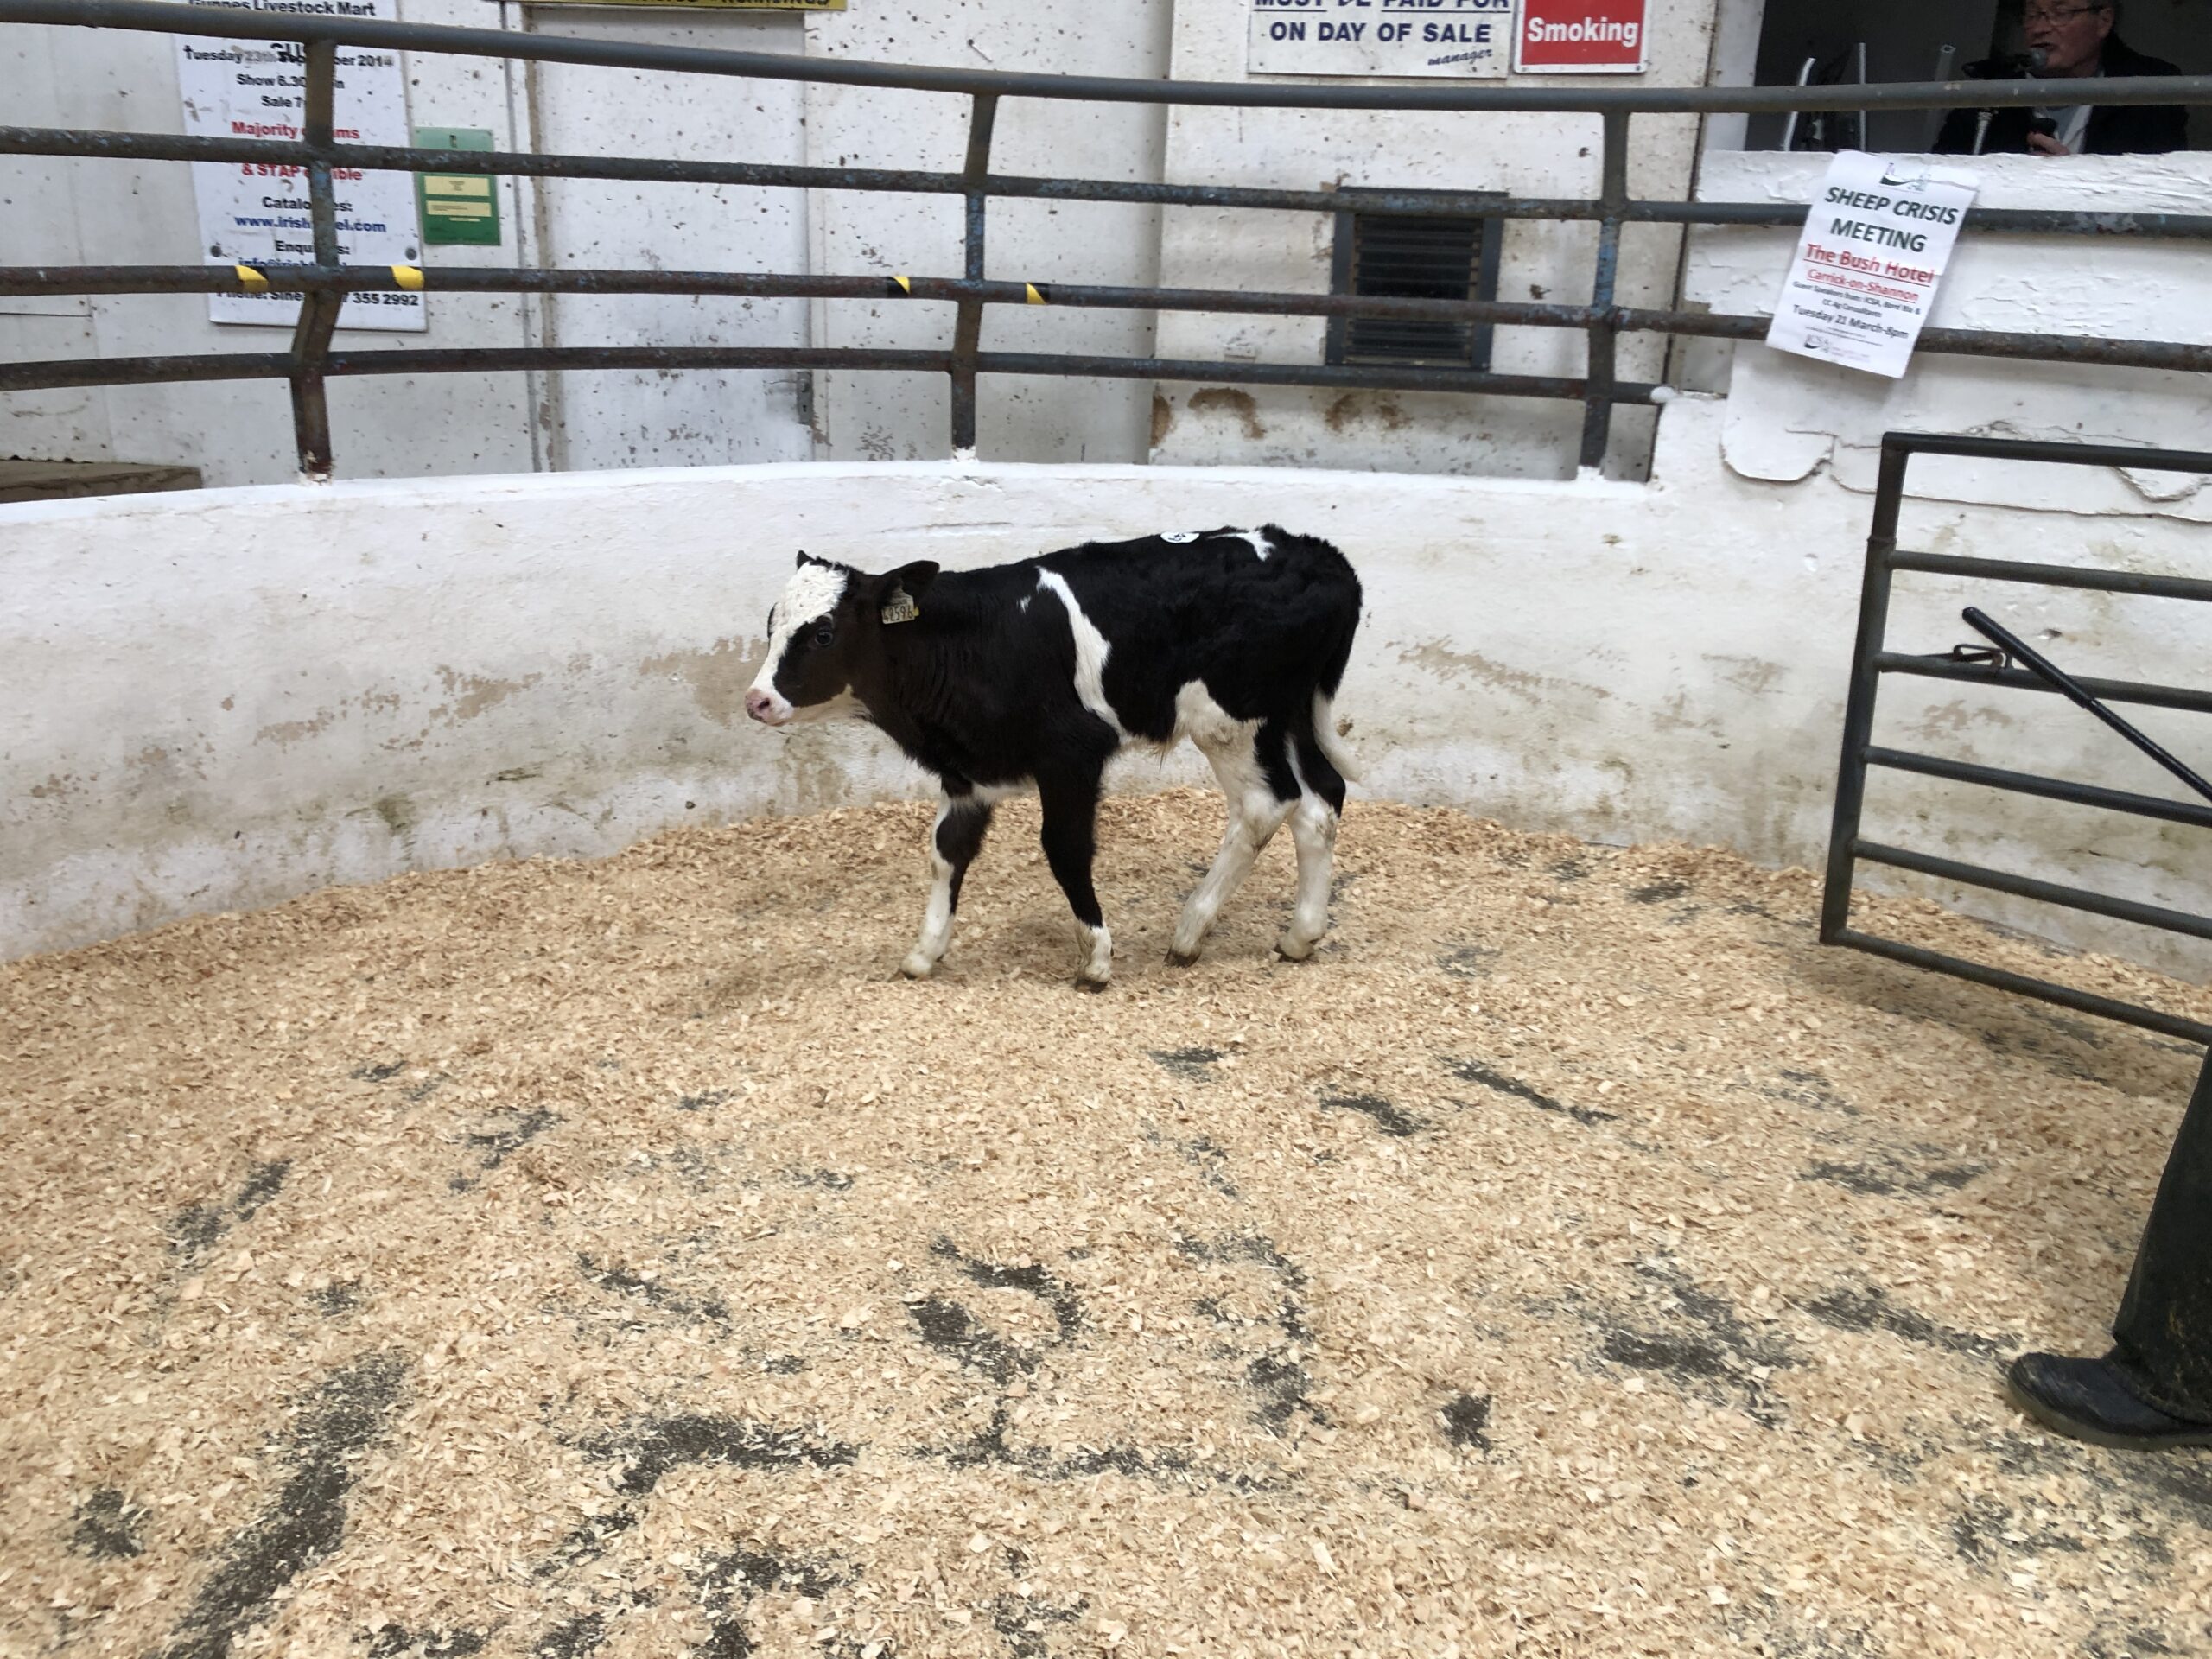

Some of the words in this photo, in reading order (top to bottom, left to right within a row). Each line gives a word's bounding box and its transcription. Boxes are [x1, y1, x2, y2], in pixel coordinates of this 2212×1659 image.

[254, 0, 334, 14] Livestock
[337, 2, 376, 16] Mart
[1269, 22, 1306, 41] ON
[1319, 22, 1366, 41] DAY
[1377, 23, 1412, 42] OF
[1422, 23, 1491, 43] SALE
[1528, 17, 1638, 48] Smoking
[183, 45, 242, 64] Tuesday
[1427, 48, 1493, 67] manager
[236, 73, 276, 86] Show
[261, 95, 292, 108] Sale
[232, 121, 298, 139] Majority
[241, 162, 254, 175] &
[257, 163, 301, 177] STAP
[262, 196, 353, 212] Cataloes:
[1824, 186, 1891, 211] SHEEP
[1892, 200, 1960, 225] CRISIS
[234, 216, 386, 232] www.irishel.com
[1829, 217, 1928, 252] MEETING
[1807, 243, 1836, 263] The
[1840, 251, 1880, 272] Bush
[1885, 261, 1936, 284] Hotel
[1807, 269, 1919, 301] Carrick-on-Shannon
[353, 292, 380, 304] 355
[382, 293, 419, 306] 2992
[1793, 304, 1834, 323] Tuesday
[1834, 315, 1847, 326] 21
[1849, 317, 1910, 339] March-8pm
